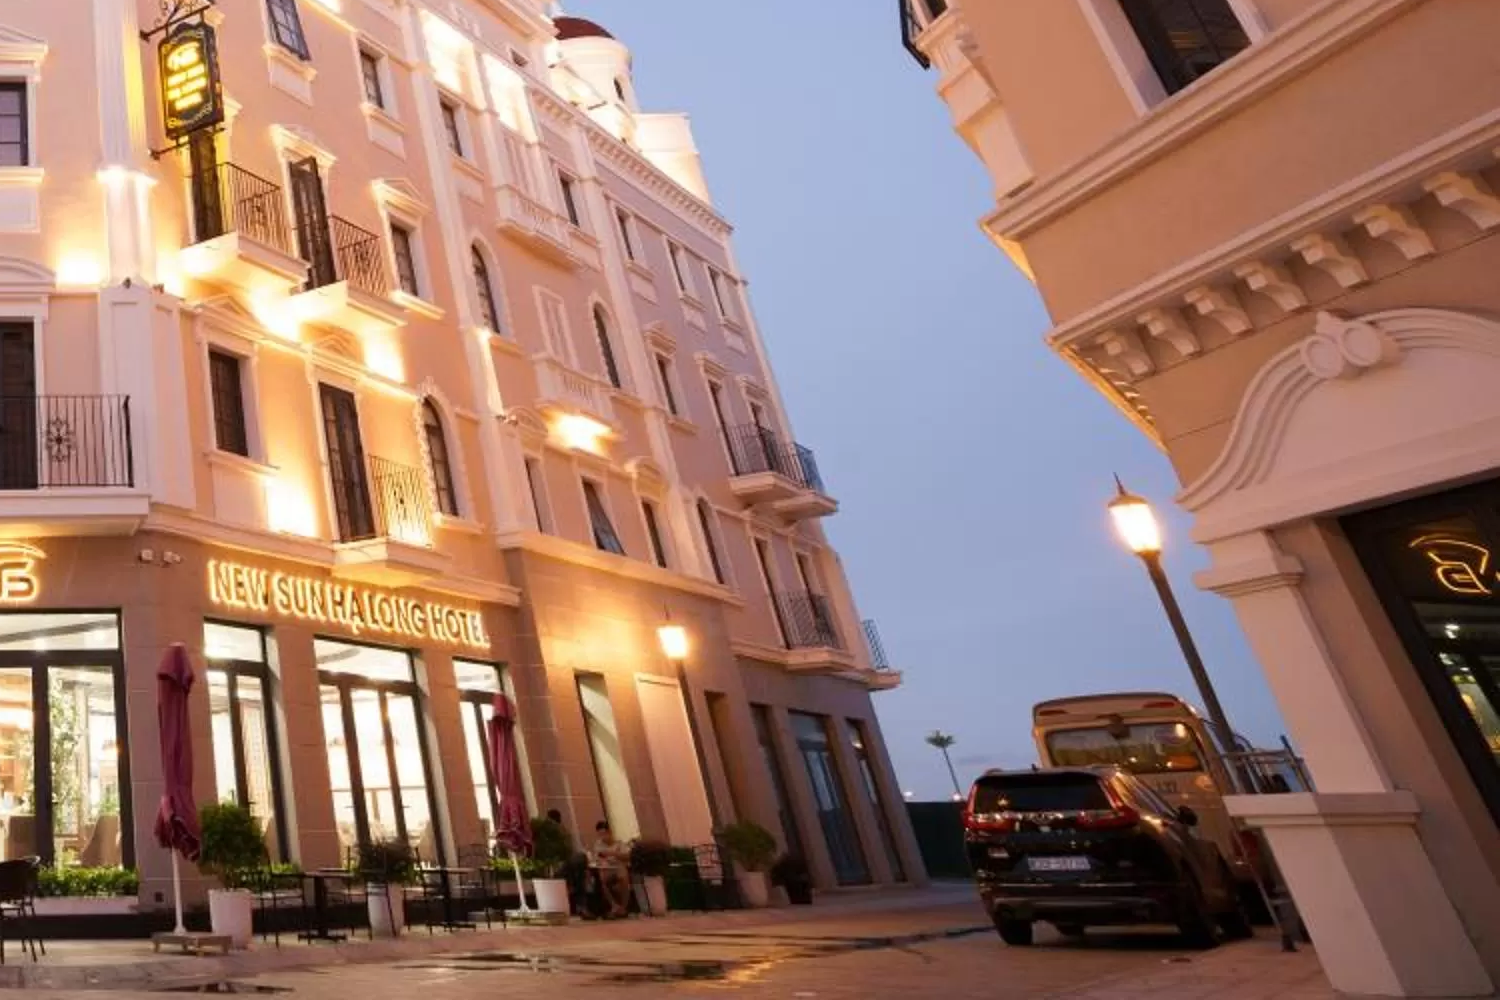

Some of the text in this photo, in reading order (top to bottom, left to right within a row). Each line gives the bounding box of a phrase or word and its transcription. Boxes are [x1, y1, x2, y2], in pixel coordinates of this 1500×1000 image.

[207, 558, 268, 612] NEW
[272, 571, 326, 621] SUN
[362, 590, 426, 638] LONG
[426, 601, 491, 648] HOTEL
